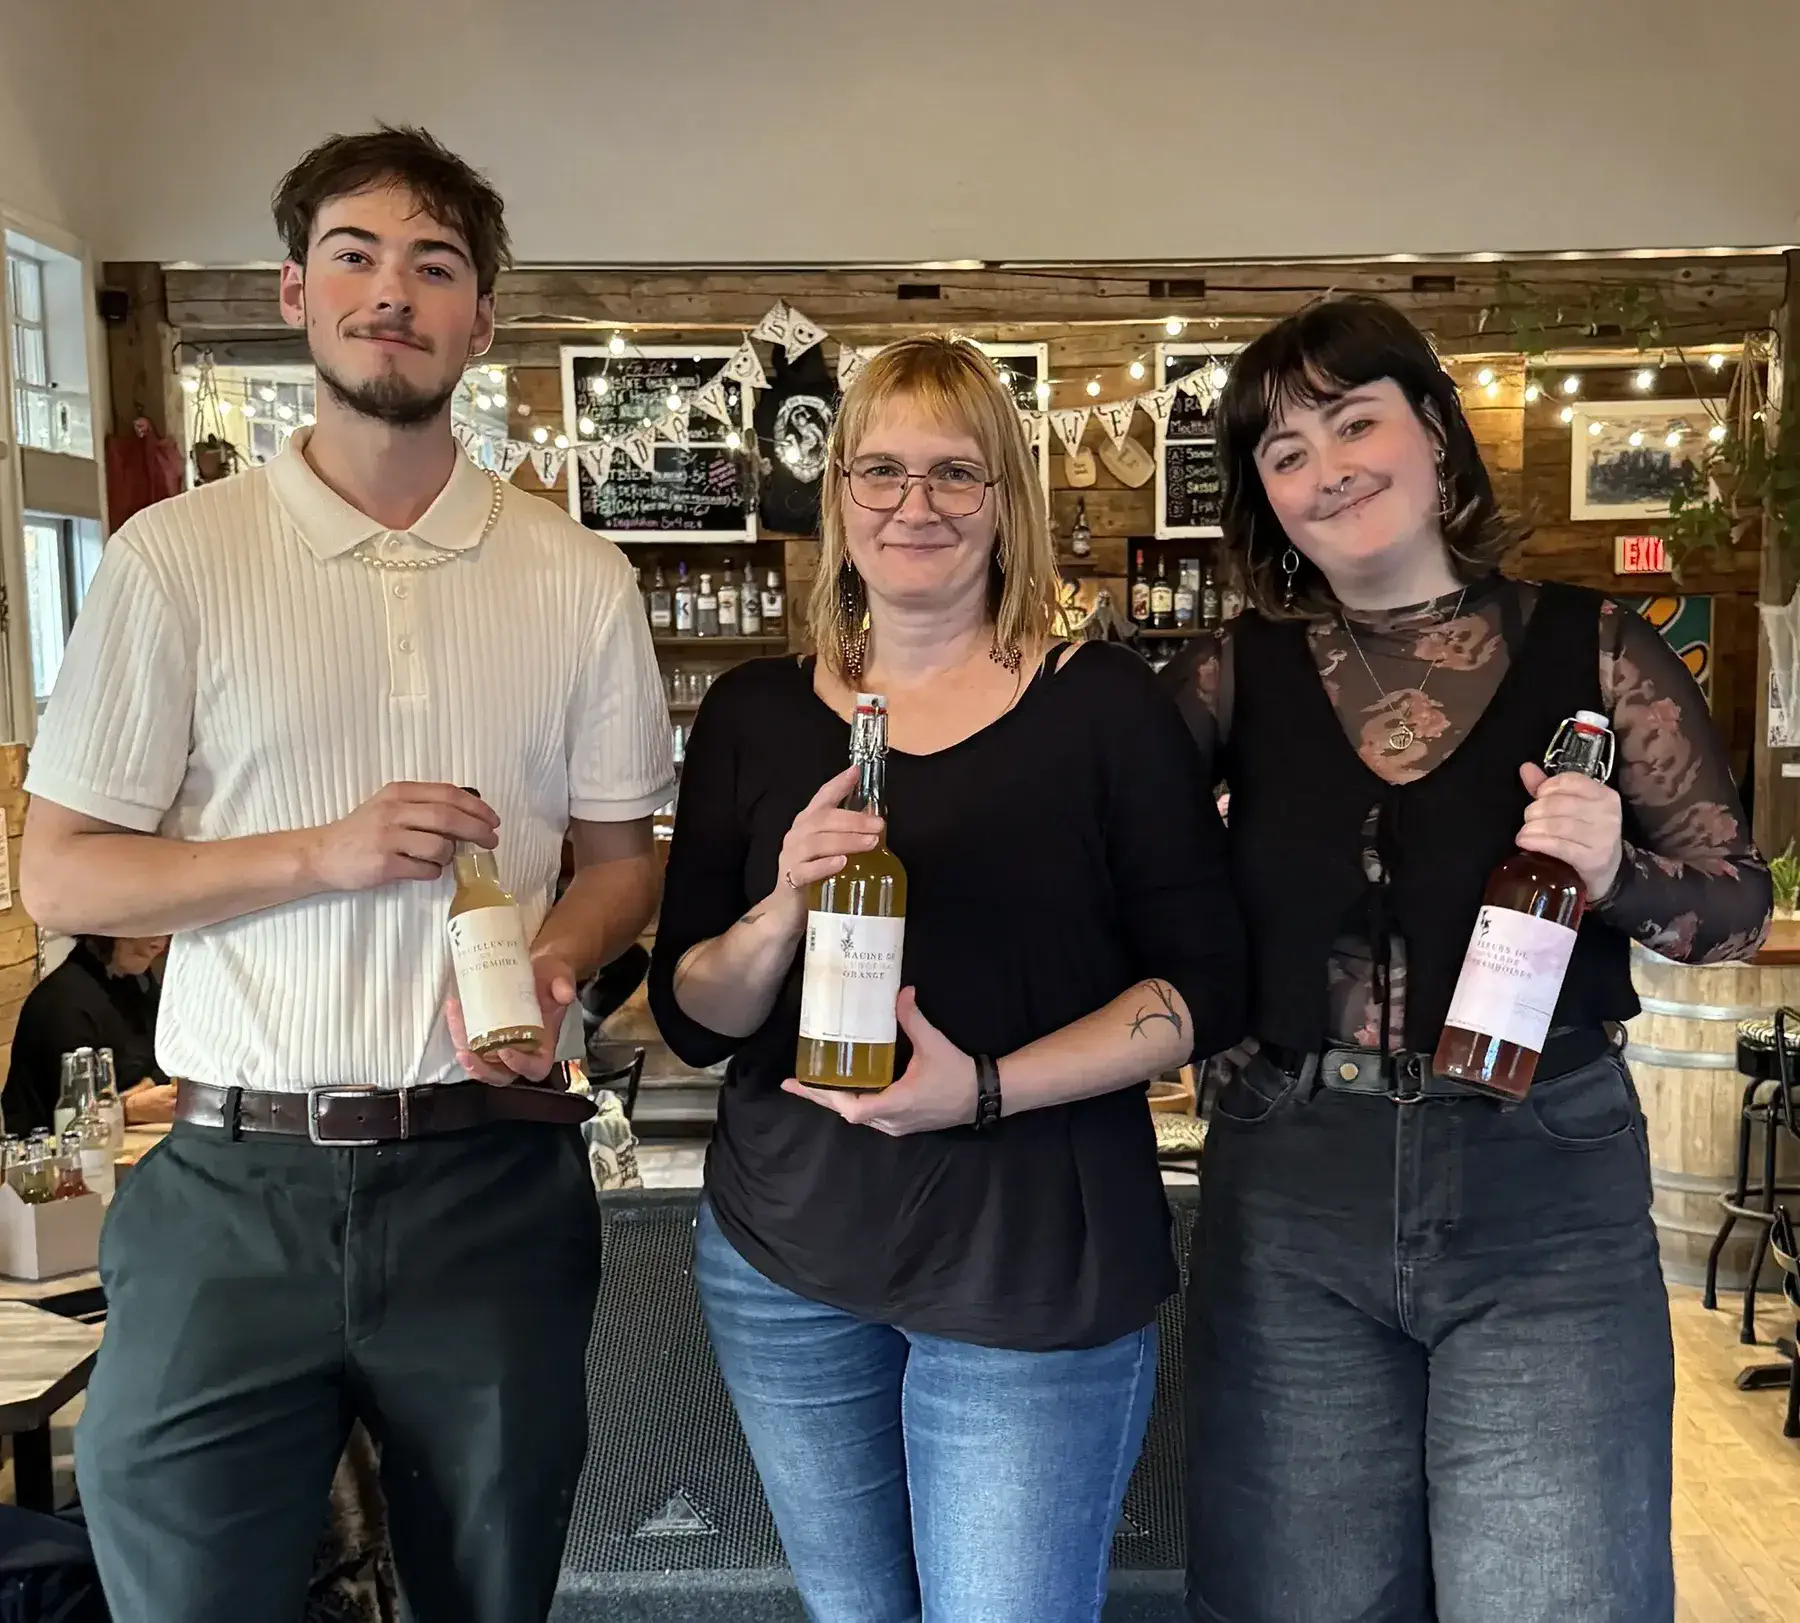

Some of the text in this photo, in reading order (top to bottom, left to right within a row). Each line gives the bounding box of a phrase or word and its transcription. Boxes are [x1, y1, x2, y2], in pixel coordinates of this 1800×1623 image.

[1625, 536, 1664, 572] EXIT
[843, 951, 884, 961] RACINE
[842, 969, 885, 980] ORANGE
